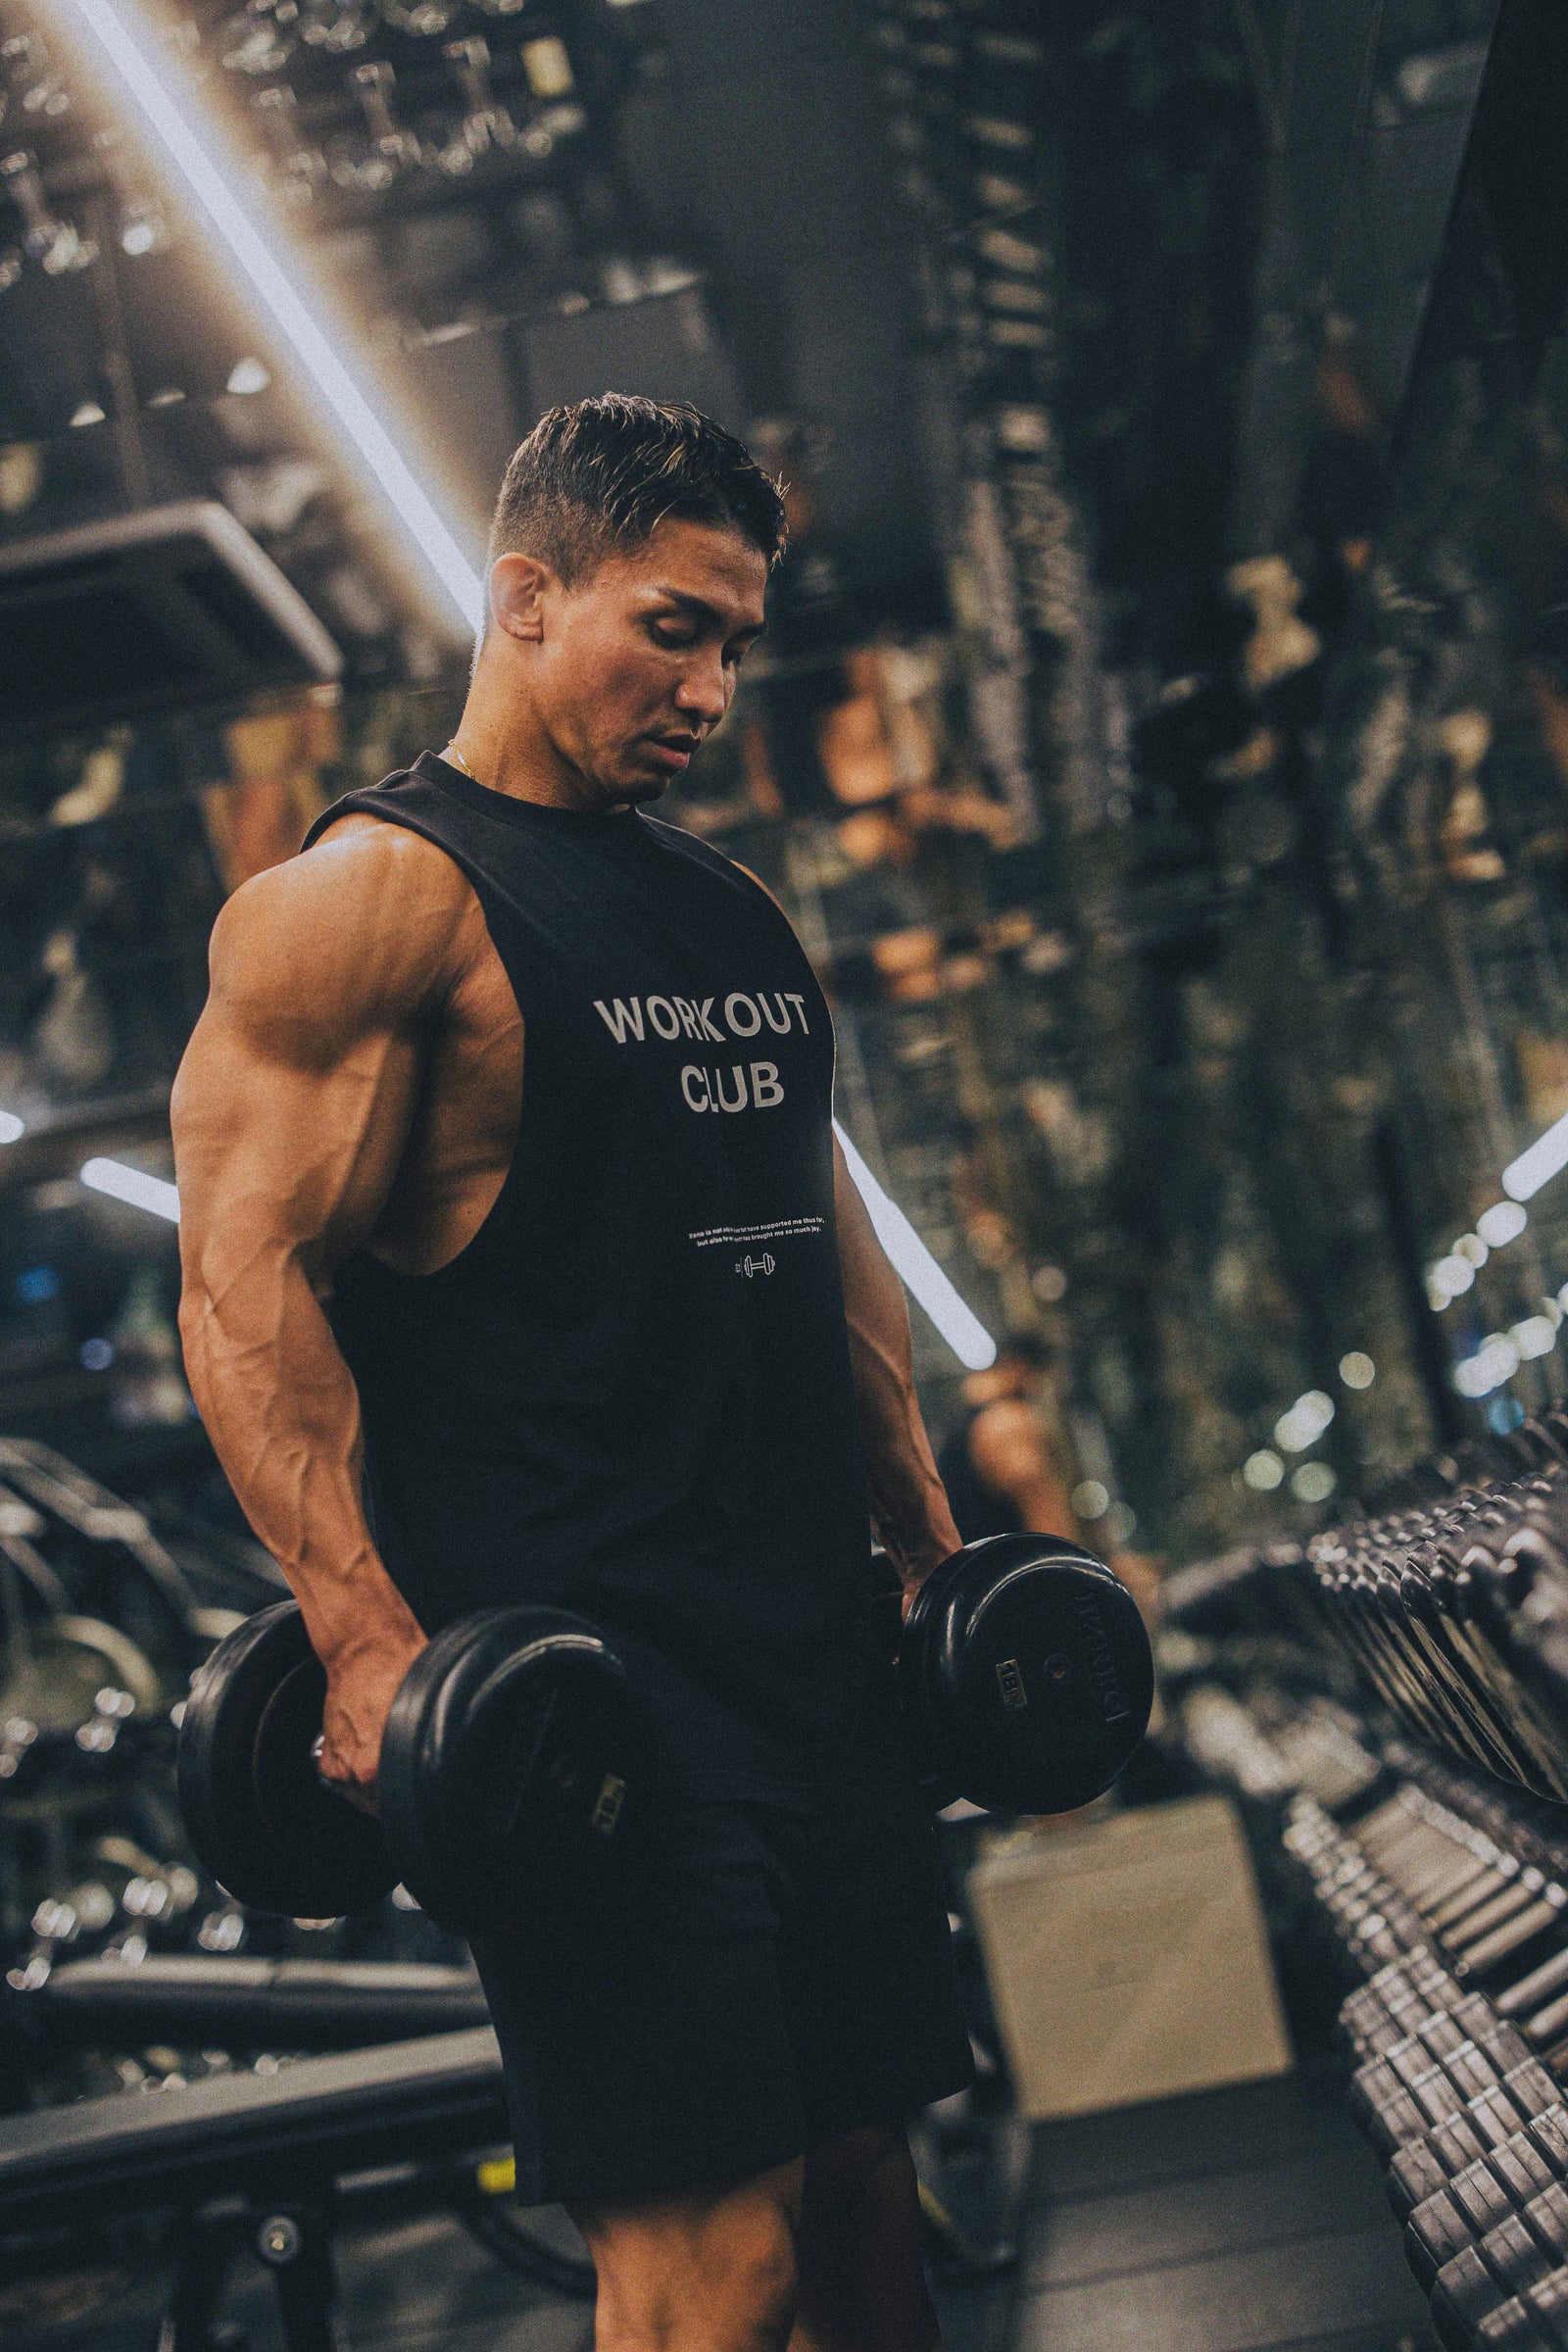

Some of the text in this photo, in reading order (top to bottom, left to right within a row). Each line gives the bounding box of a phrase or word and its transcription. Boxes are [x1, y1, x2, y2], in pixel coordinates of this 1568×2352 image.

[681, 1061, 784, 1113] CLUB
[760, 1220, 792, 1231] supported
[697, 1239, 709, 1248] but
[751, 1232, 773, 1241] brought
